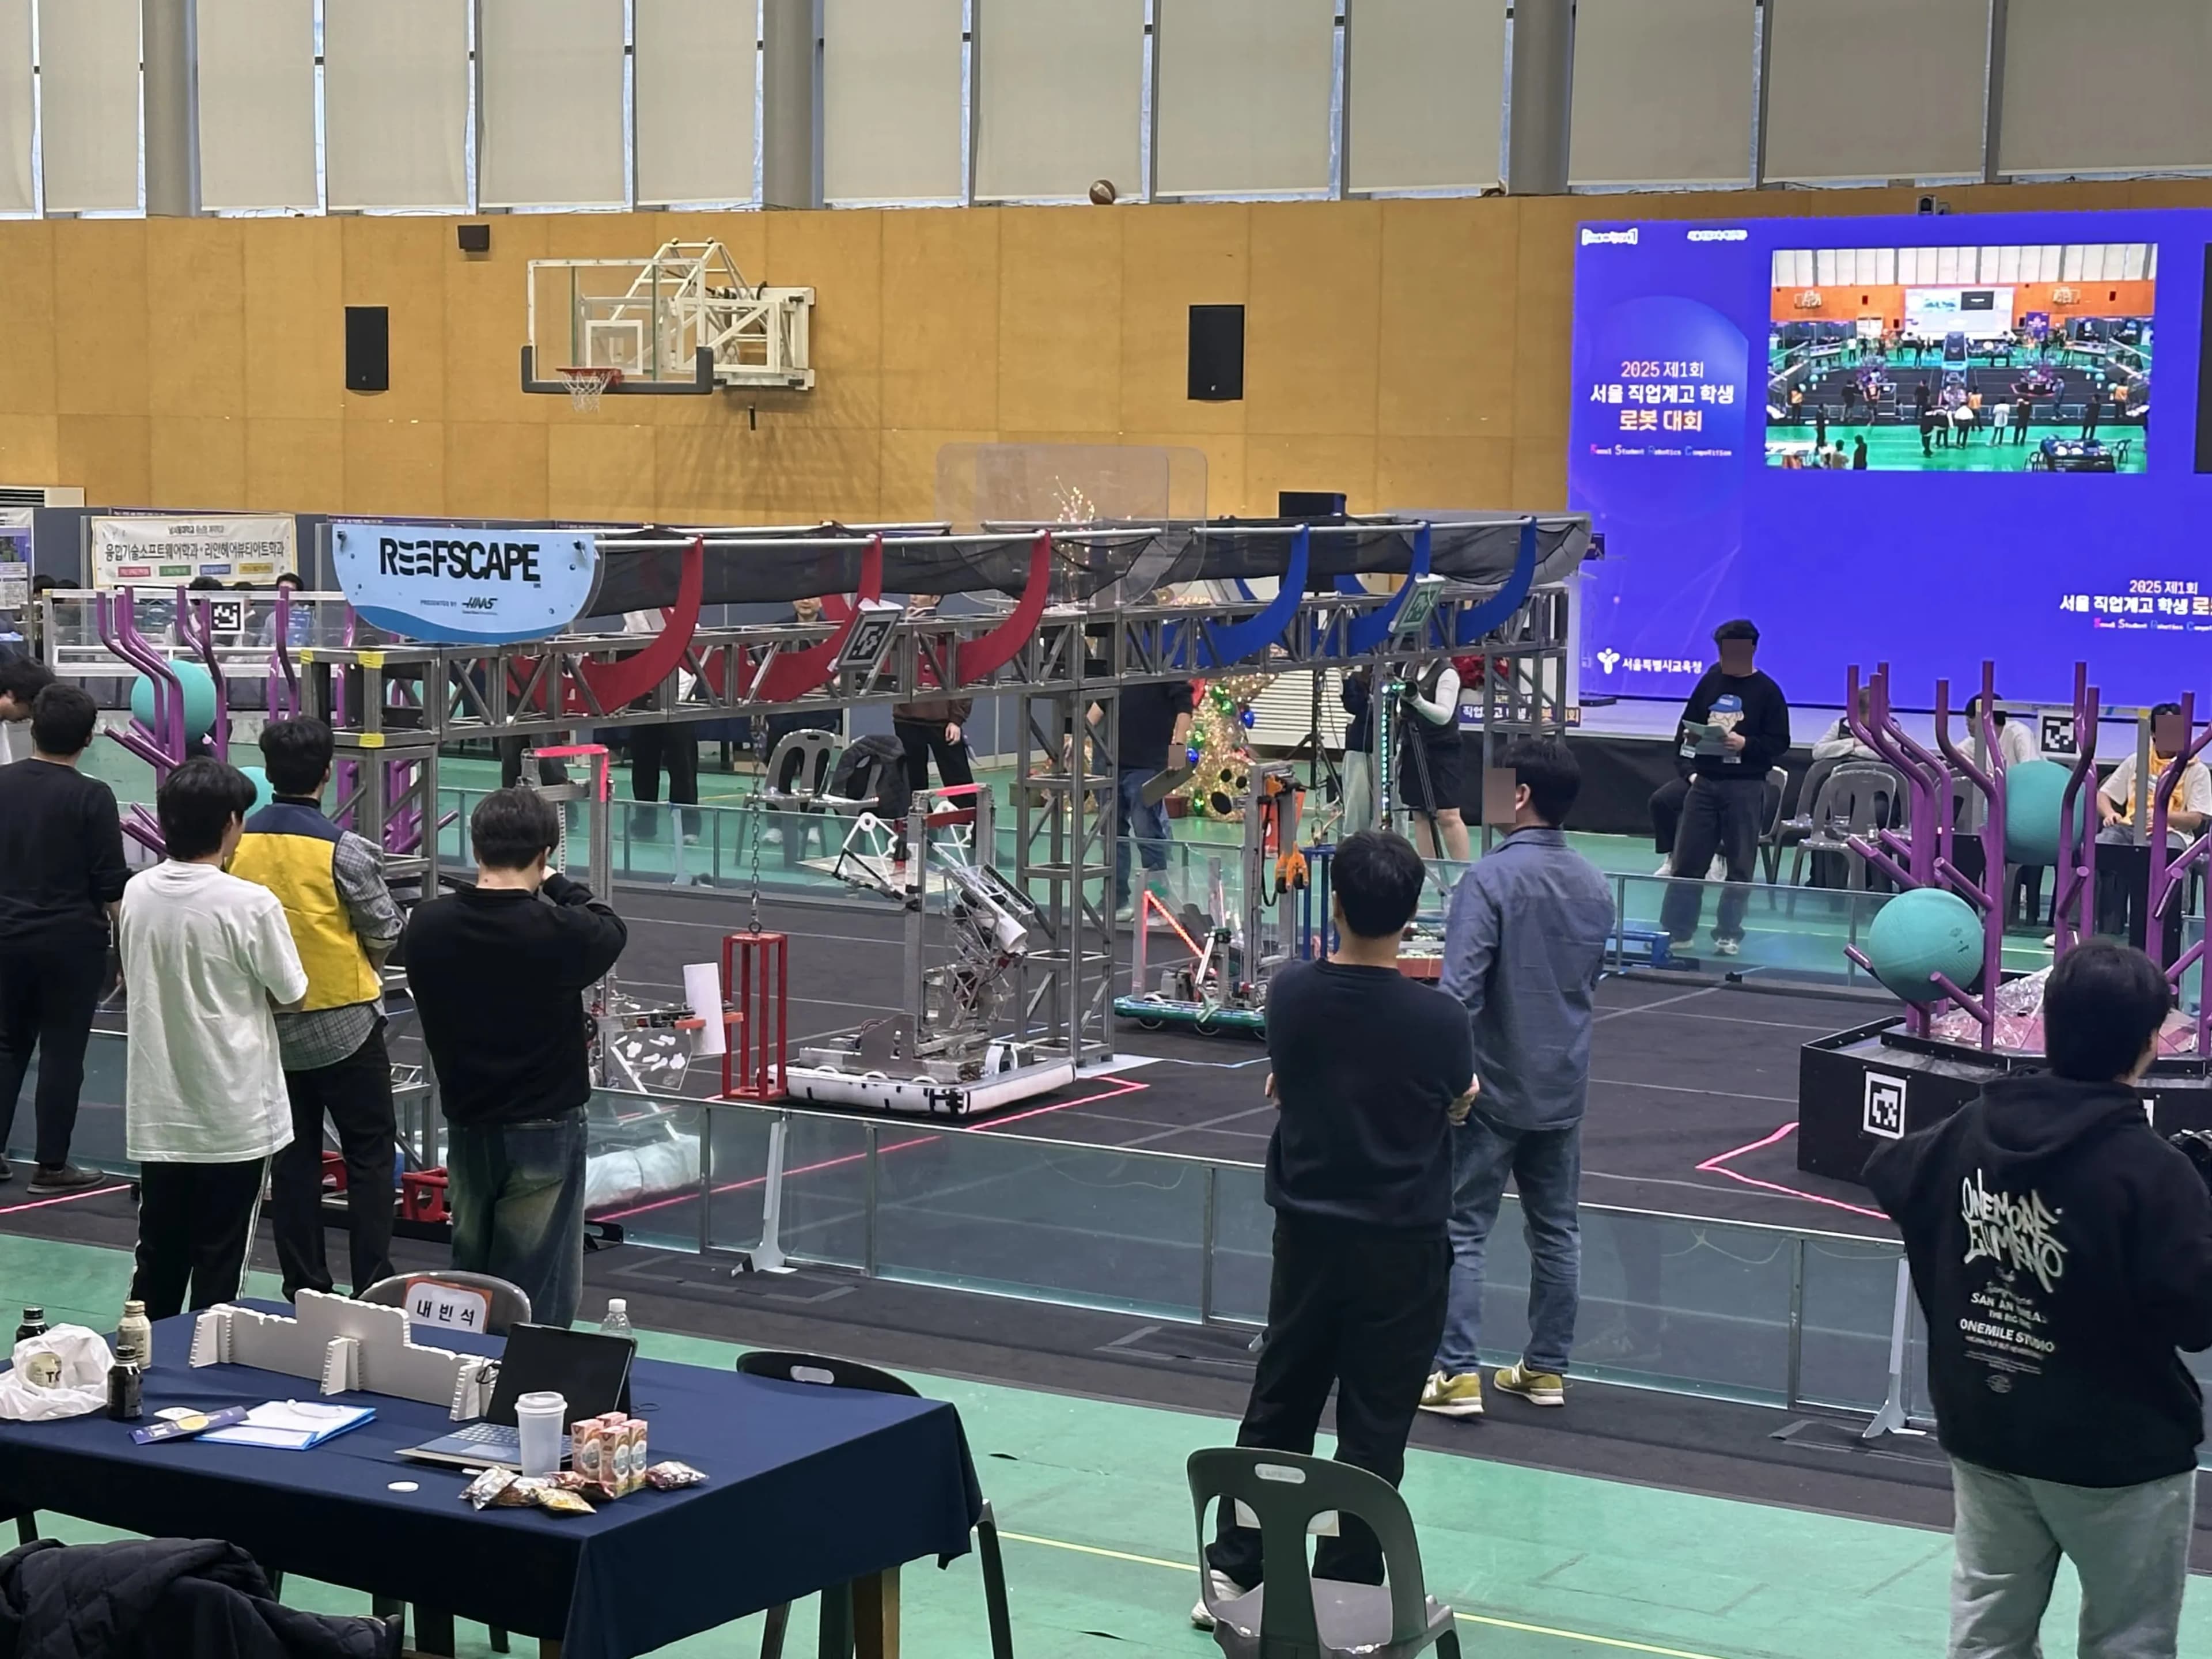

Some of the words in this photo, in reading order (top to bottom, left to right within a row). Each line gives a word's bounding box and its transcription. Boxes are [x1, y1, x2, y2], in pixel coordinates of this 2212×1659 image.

[1621, 361, 1660, 377] 2025
[1663, 362, 1703, 378] 제1회
[1590, 384, 1623, 403] 서울
[1628, 384, 1695, 403] 직업계고
[1700, 384, 1734, 403] 학생
[1619, 410, 1658, 431] 로봇
[1663, 410, 1702, 431] 대회
[380, 537, 541, 582] REEFSCAPE
[2129, 580, 2162, 593] 2025
[2164, 581, 2198, 594] 제1회
[2060, 594, 2089, 612] 서울
[2094, 596, 2153, 613] 직업계고
[2157, 597, 2188, 615] 학생
[2192, 596, 2212, 615] 로
[1622, 658, 1702, 674] 서울특별시교육청
[1463, 706, 1503, 718] 직업고
[1971, 1293, 1995, 1307] SAN
[1960, 1319, 2014, 1340] ONEMILE
[2015, 1332, 2055, 1352] STUDIO
